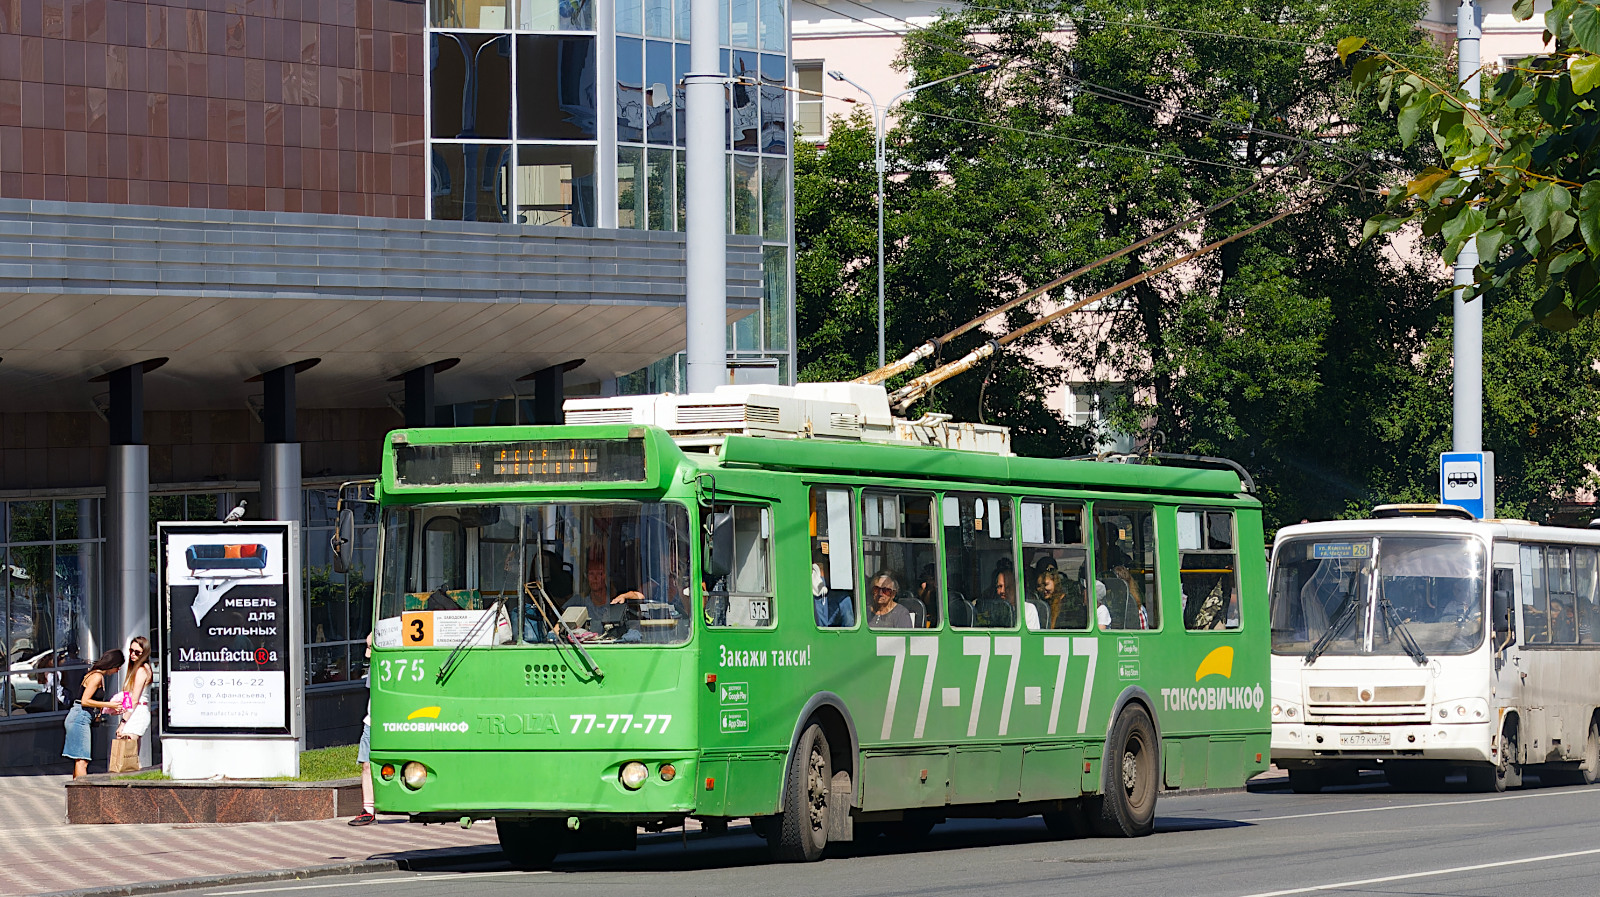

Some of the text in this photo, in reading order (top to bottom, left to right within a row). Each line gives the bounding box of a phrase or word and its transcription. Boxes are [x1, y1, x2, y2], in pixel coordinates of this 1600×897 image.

[1354, 545, 1365, 556] 26
[225, 599, 277, 607] МЕБЕЛЬ
[248, 612, 276, 622] ДЛЯ
[752, 602, 767, 619] 375
[208, 627, 277, 636] СТИЛЬНЫХ
[410, 619, 424, 642] 3
[719, 644, 811, 667] Закажи такси!
[380, 659, 425, 682] 375
[209, 678, 264, 687] 63-16-22
[876, 636, 1099, 741] 77-77-77
[728, 692, 740, 702] Google
[476, 713, 560, 735] TROLZA
[570, 714, 672, 734] 77-77-77
[728, 718, 747, 730] App Store
